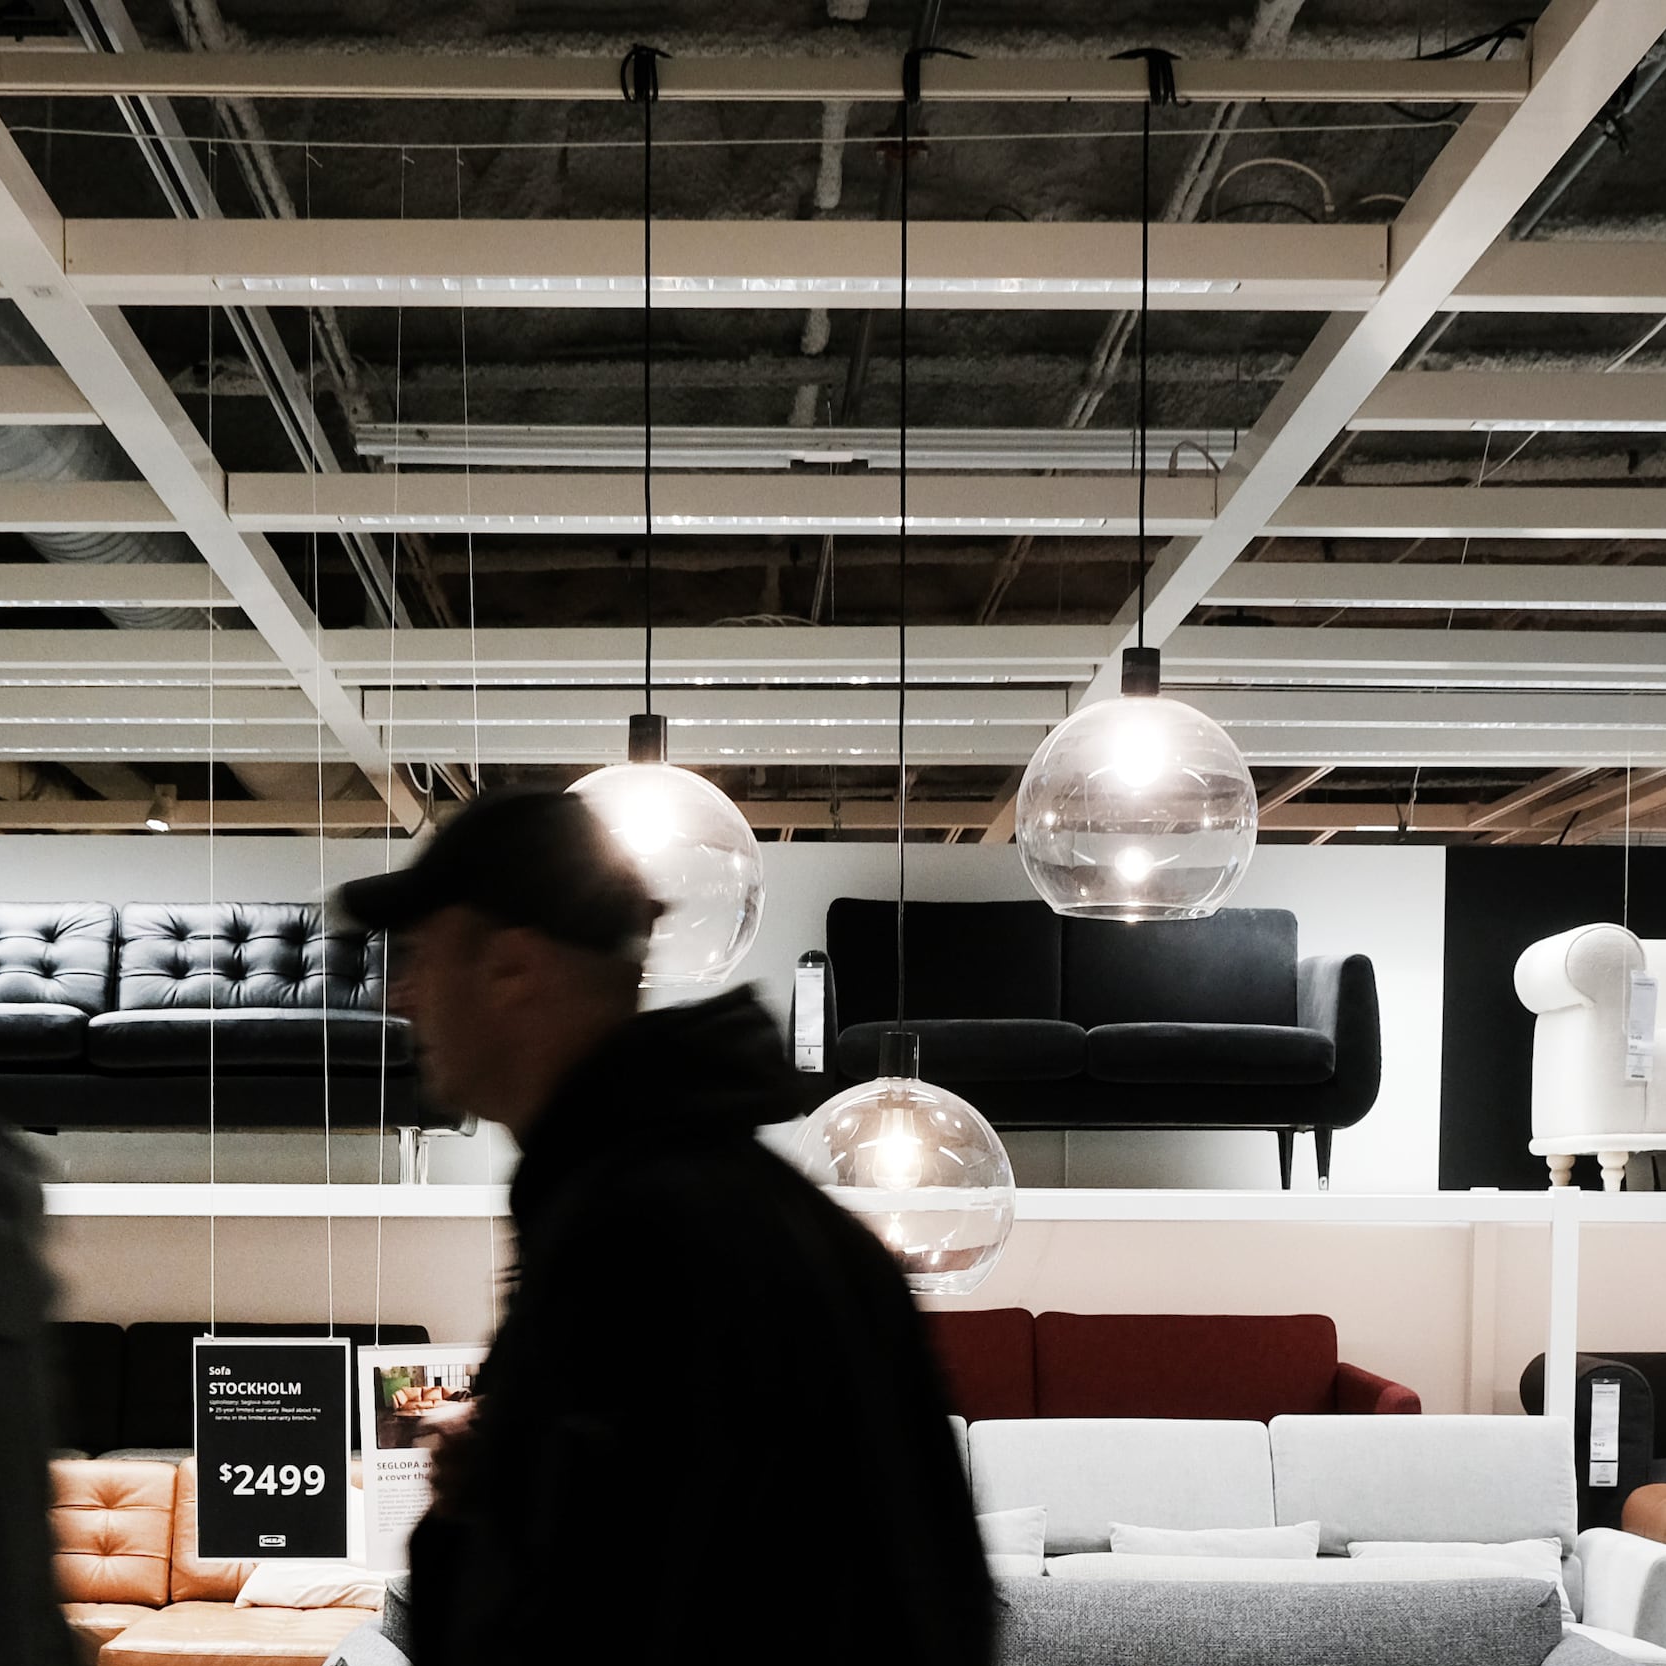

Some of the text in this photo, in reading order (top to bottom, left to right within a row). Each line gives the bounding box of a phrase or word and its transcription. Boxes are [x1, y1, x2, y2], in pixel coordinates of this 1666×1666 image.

[208, 1365, 232, 1376] Sofa
[208, 1381, 302, 1396] STOCKHOLM
[218, 1462, 326, 1496] $2499
[385, 1473, 412, 1481] cover
[413, 1471, 431, 1481] tha
